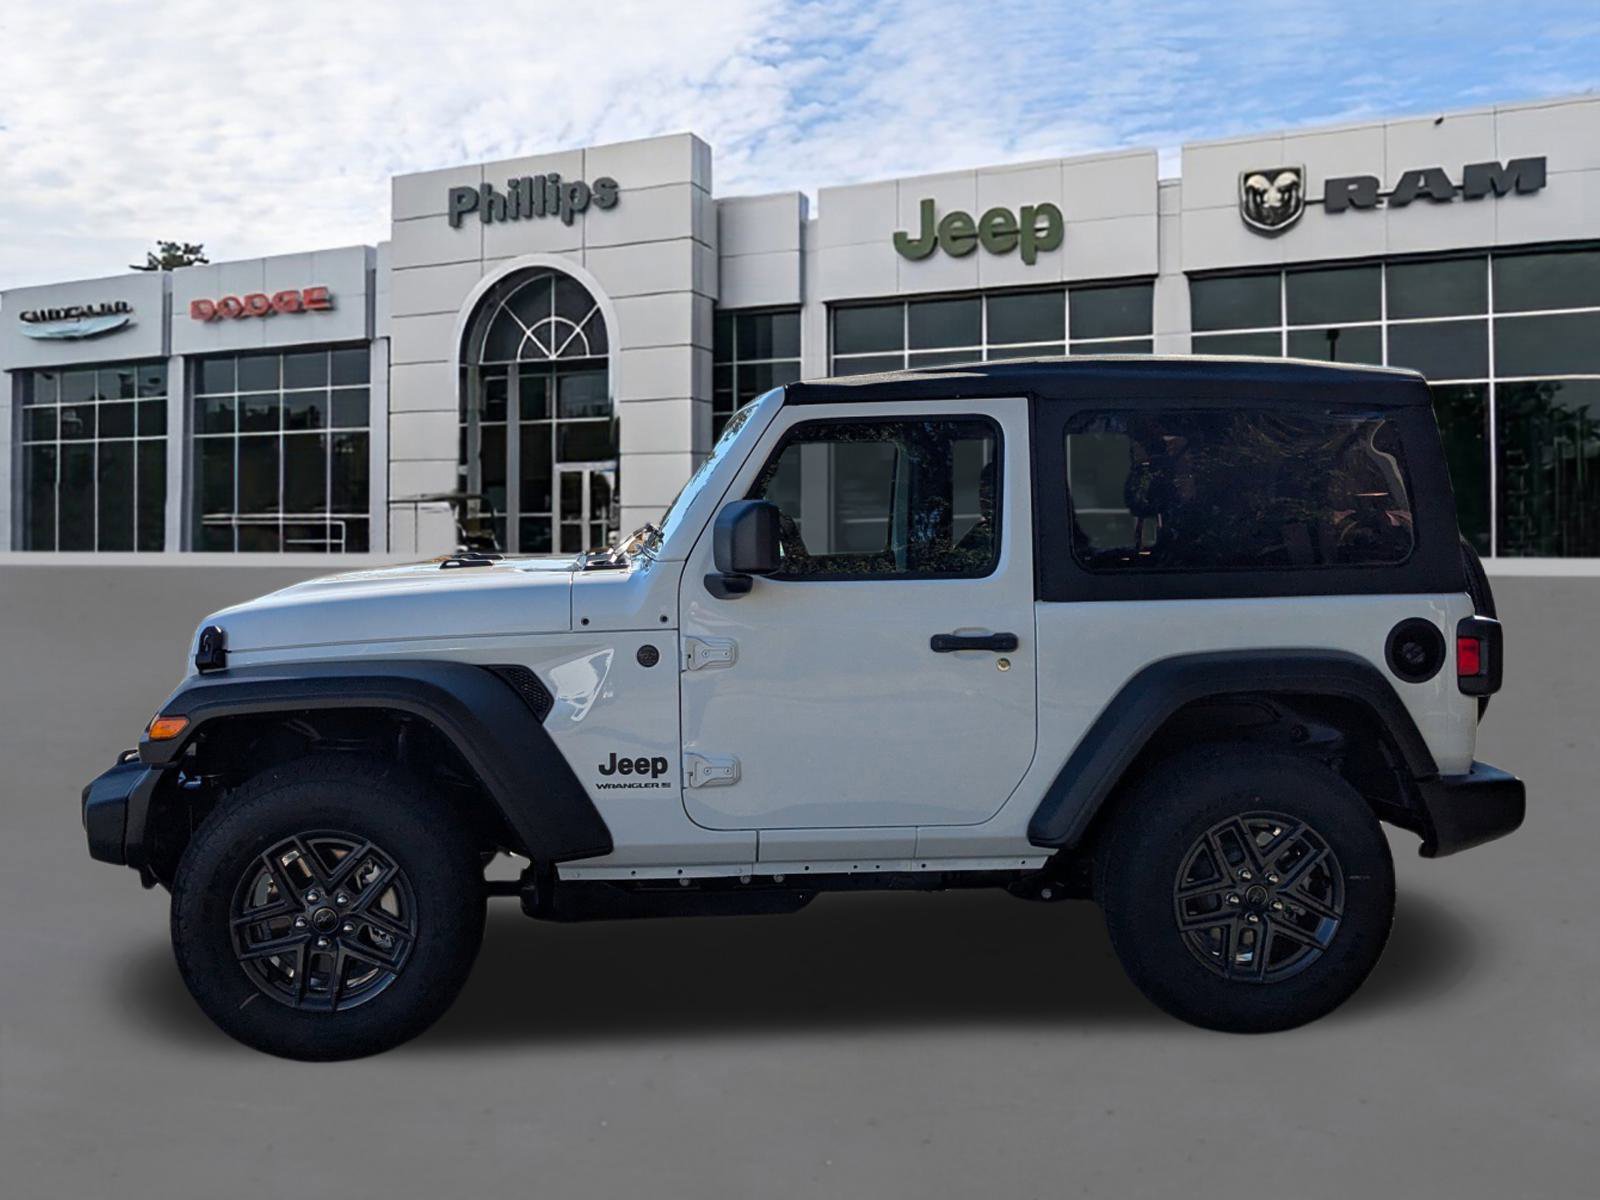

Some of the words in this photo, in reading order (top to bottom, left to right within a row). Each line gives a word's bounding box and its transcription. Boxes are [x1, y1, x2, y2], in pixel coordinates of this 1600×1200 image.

[449, 173, 619, 228] Phillips
[1325, 156, 1547, 213] RAM
[893, 198, 1064, 266] Jeep
[190, 286, 335, 322] DODGE
[598, 752, 668, 778] Jeep
